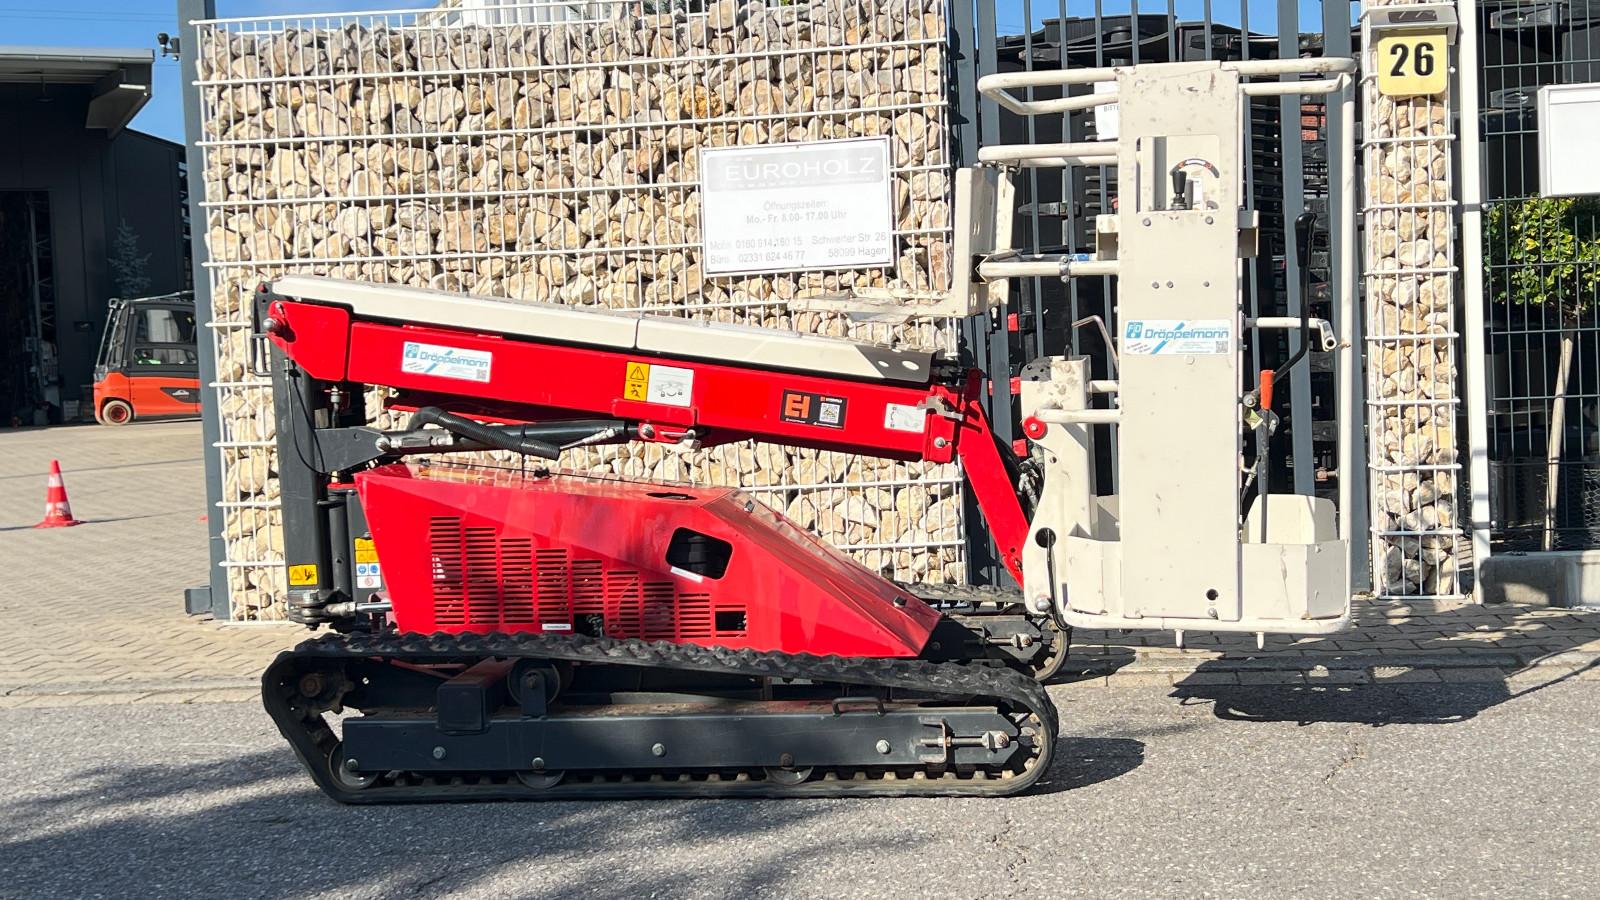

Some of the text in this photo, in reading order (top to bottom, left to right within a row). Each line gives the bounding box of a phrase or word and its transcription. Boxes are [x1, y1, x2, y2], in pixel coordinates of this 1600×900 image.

[1390, 41, 1434, 76] 26
[726, 158, 875, 181] EUROHOLZ
[831, 209, 848, 219] Uhr
[795, 250, 806, 260] 77
[858, 246, 887, 257] Hagen
[1144, 328, 1229, 340] Dröppelmann
[420, 351, 488, 367] Dröppelmann
